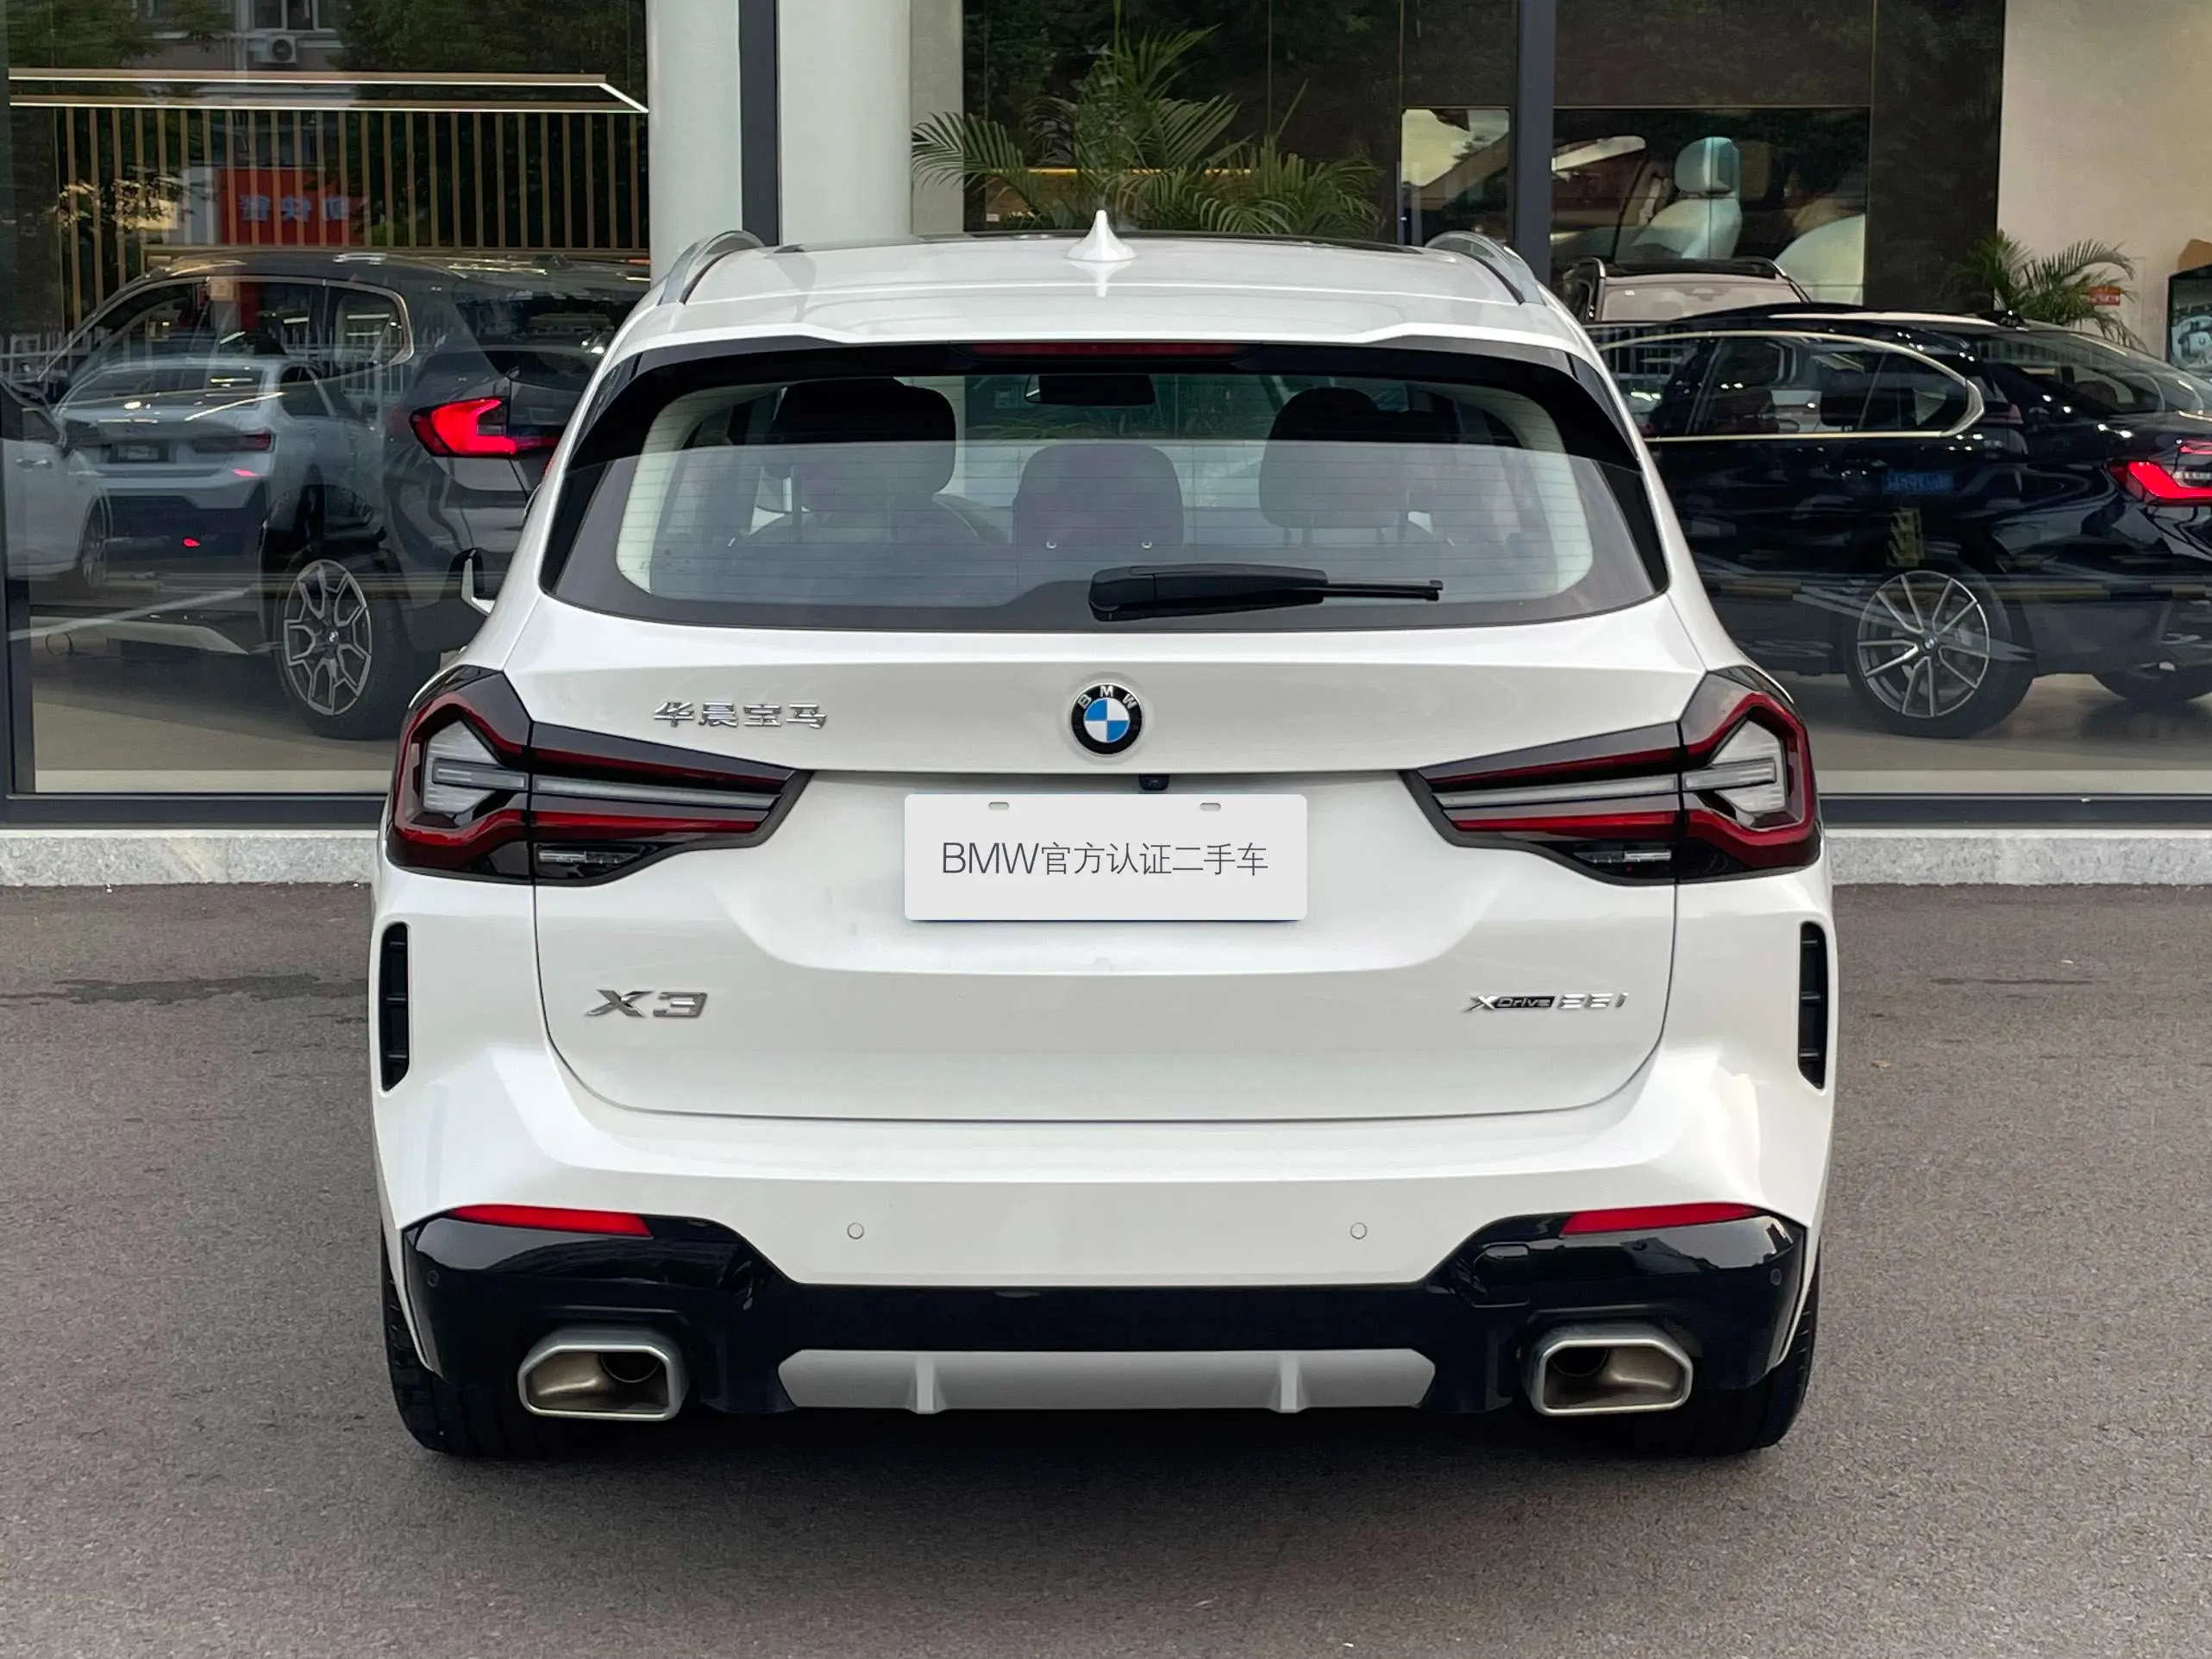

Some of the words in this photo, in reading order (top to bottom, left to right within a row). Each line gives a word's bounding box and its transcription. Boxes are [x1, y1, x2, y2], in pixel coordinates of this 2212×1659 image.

[1077, 686, 1137, 709] BMW
[653, 701, 827, 728] 华晨宝马
[942, 841, 1269, 876] BMW官方认证二手车
[583, 989, 708, 1018] X3
